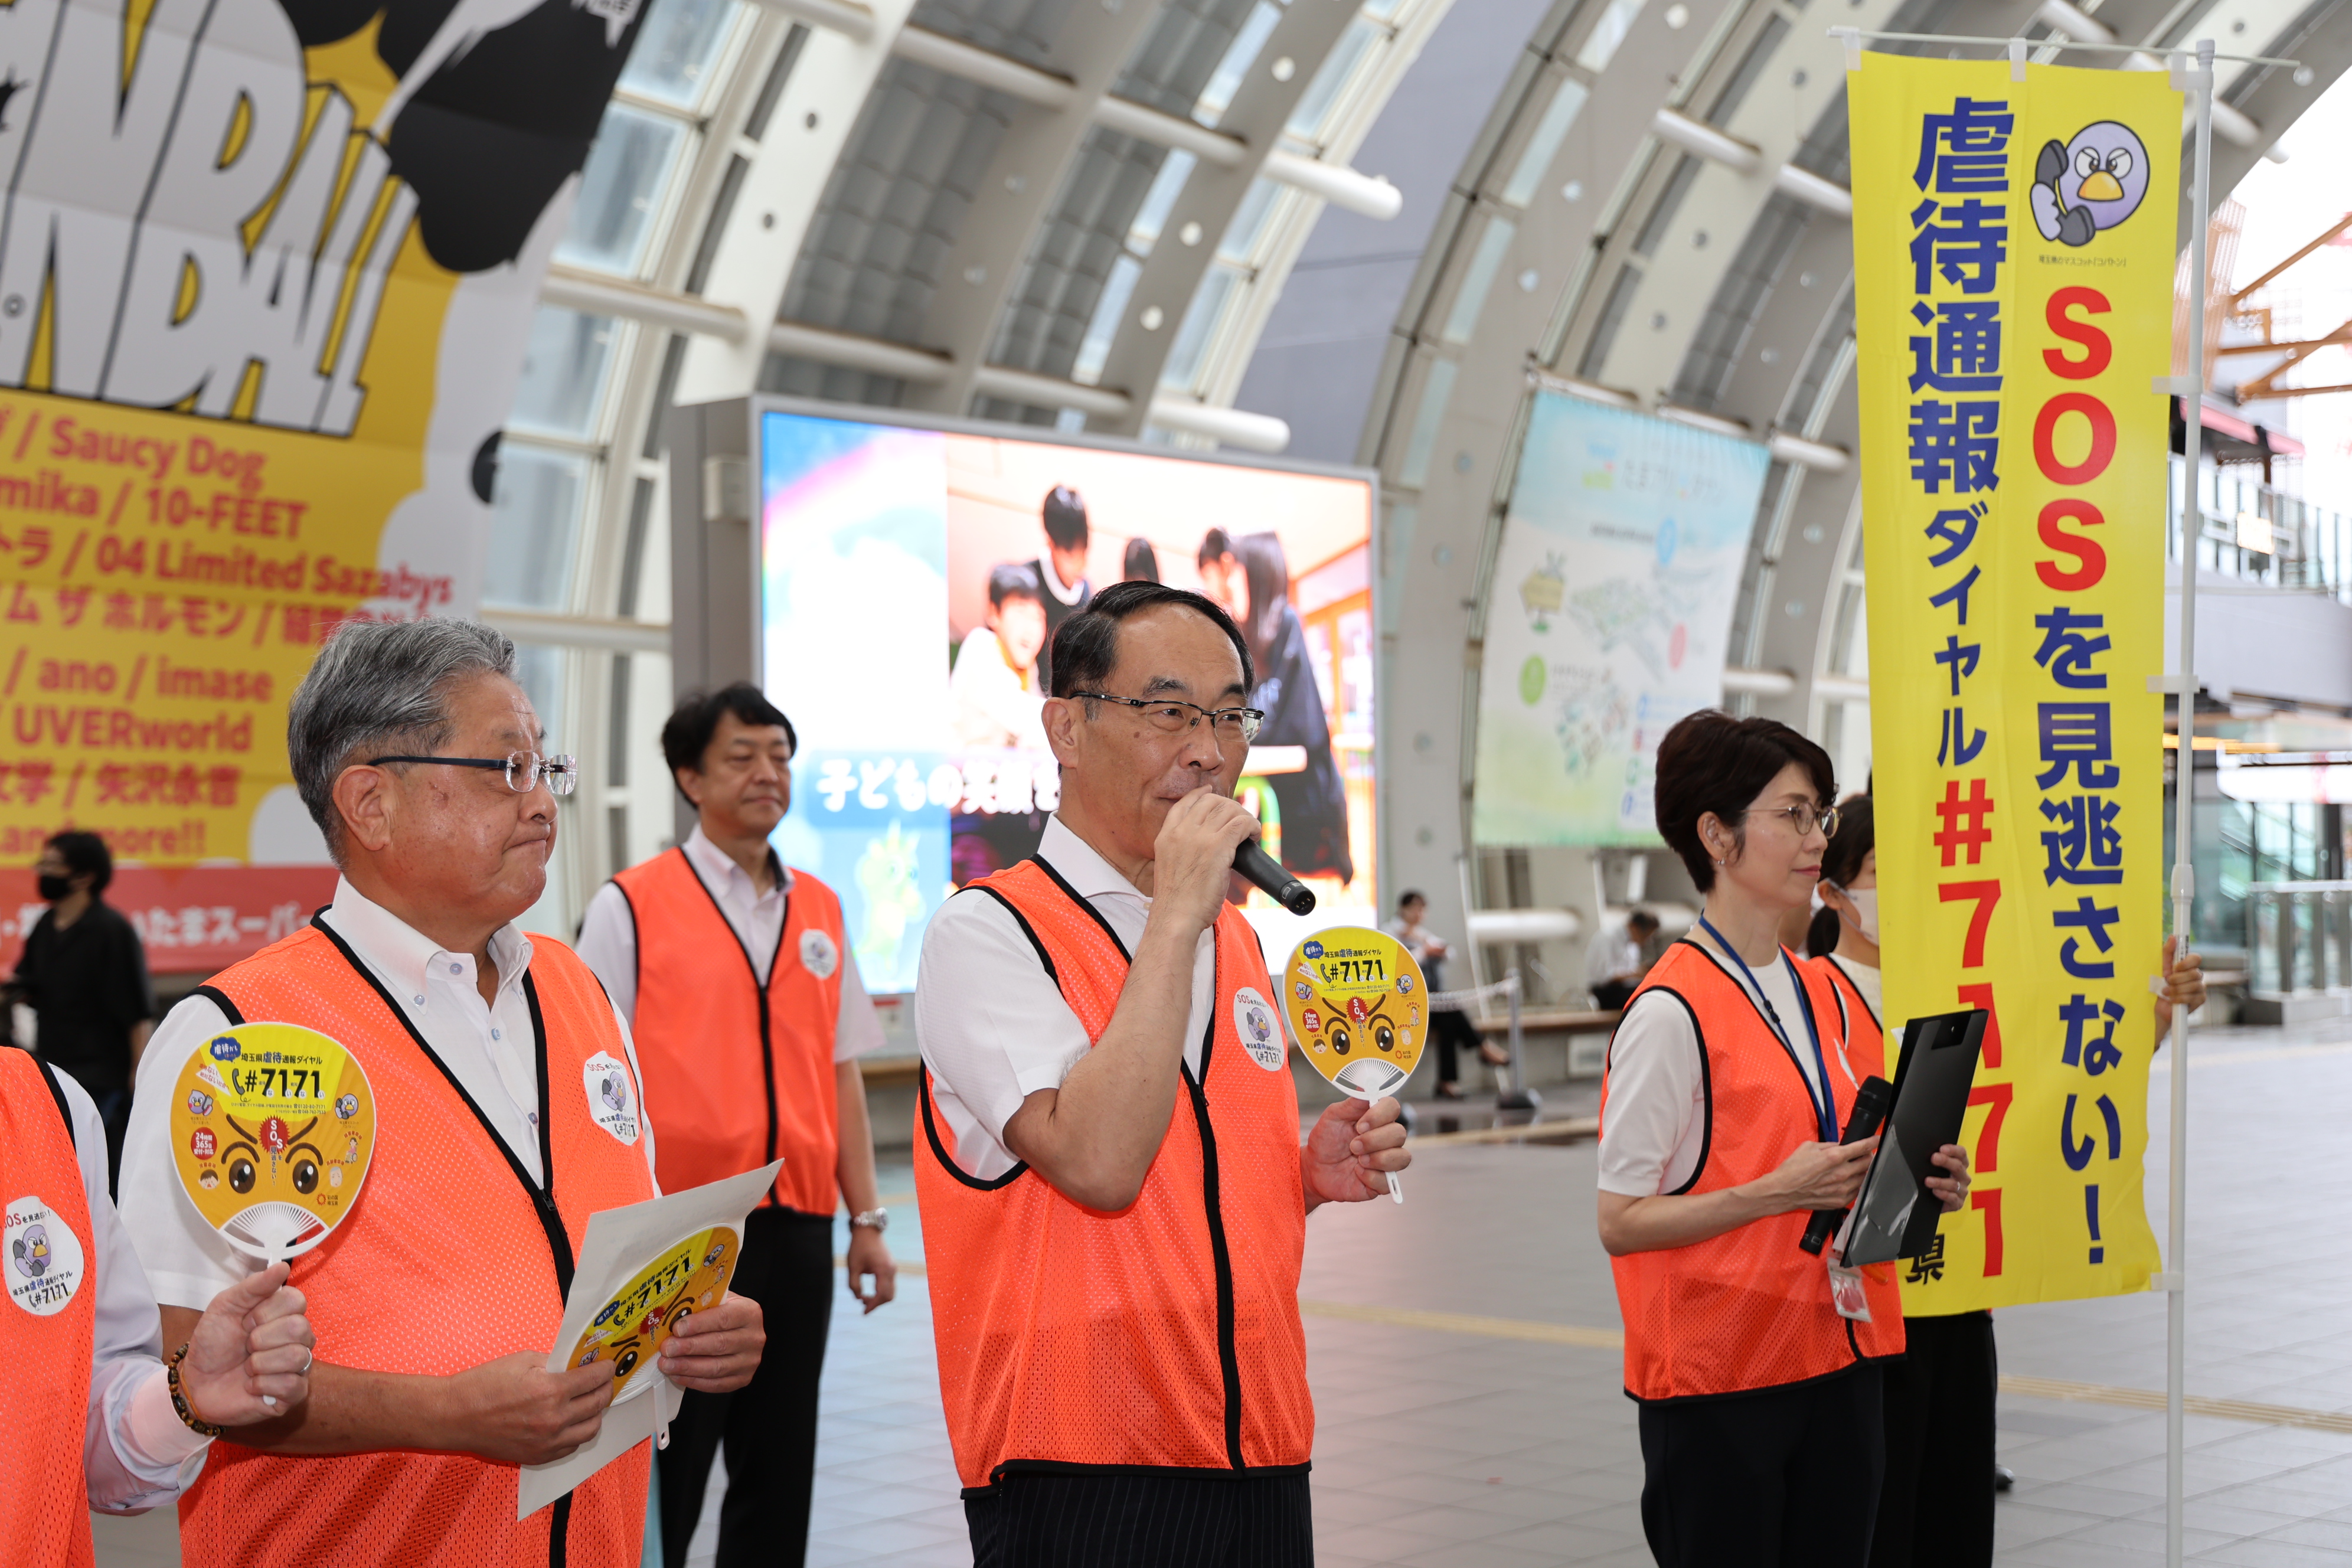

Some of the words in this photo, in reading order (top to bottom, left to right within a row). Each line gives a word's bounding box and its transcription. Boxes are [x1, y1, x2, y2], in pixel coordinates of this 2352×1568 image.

[50, 417, 178, 479] Saucy
[187, 436, 267, 494] Dog
[146, 487, 309, 540] 10-FEET
[96, 533, 146, 575] 04
[156, 540, 306, 591] Limited
[313, 554, 453, 612] Sazabys
[38, 659, 117, 692] ano
[157, 654, 274, 701] imase
[13, 705, 253, 753] UVERworld
[0, 818, 76, 856] an
[1324, 949, 1381, 958] 埼玉県虐待通報ダイヤル
[1329, 959, 1383, 982] #7171
[241, 1051, 322, 1064] 埼玉県虐待通報ダイヤル
[245, 1068, 320, 1098] #7171
[195, 1132, 213, 1141] 24時間
[196, 1140, 213, 1149] 365日
[12, 1270, 73, 1296] 埼玉県虐待通報ダイヤル
[35, 1282, 69, 1305] #7171
[625, 1256, 690, 1318] #7171
